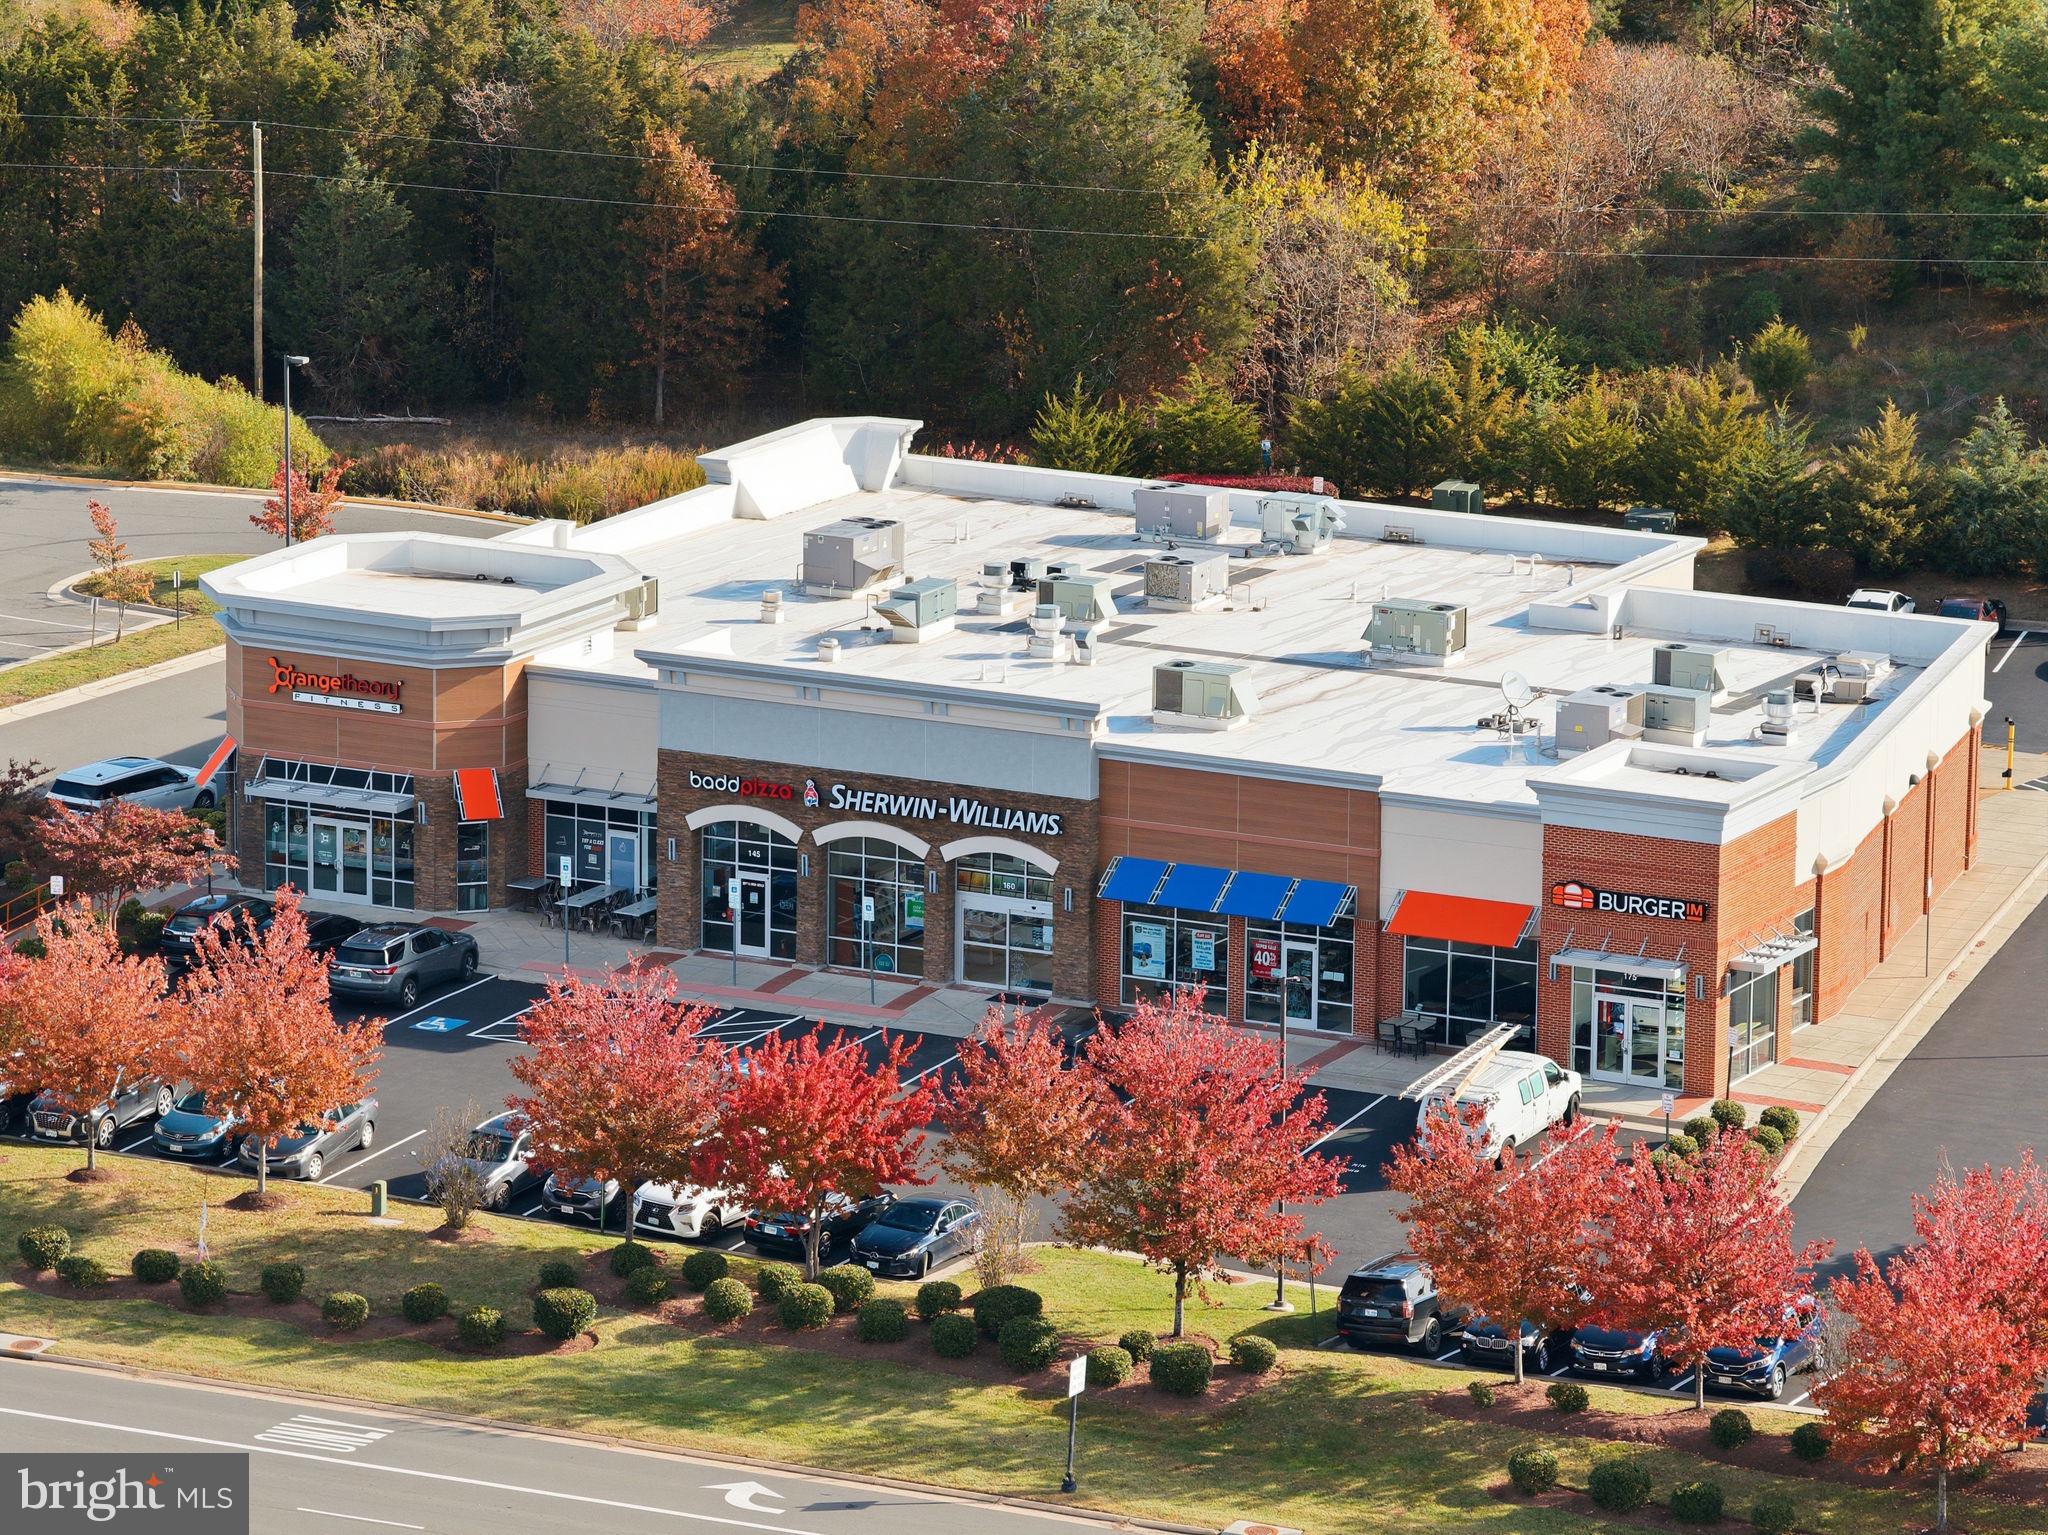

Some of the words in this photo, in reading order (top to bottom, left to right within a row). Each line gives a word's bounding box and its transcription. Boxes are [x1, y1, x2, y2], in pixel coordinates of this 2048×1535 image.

[294, 693, 399, 713] FITNESS
[829, 783, 1061, 836] SHERWIN-WILLIAMS
[748, 849, 761, 858] 145
[1003, 882, 1016, 890] 160
[1623, 973, 1638, 981] 175
[253, 1414, 395, 1453] ONLY
